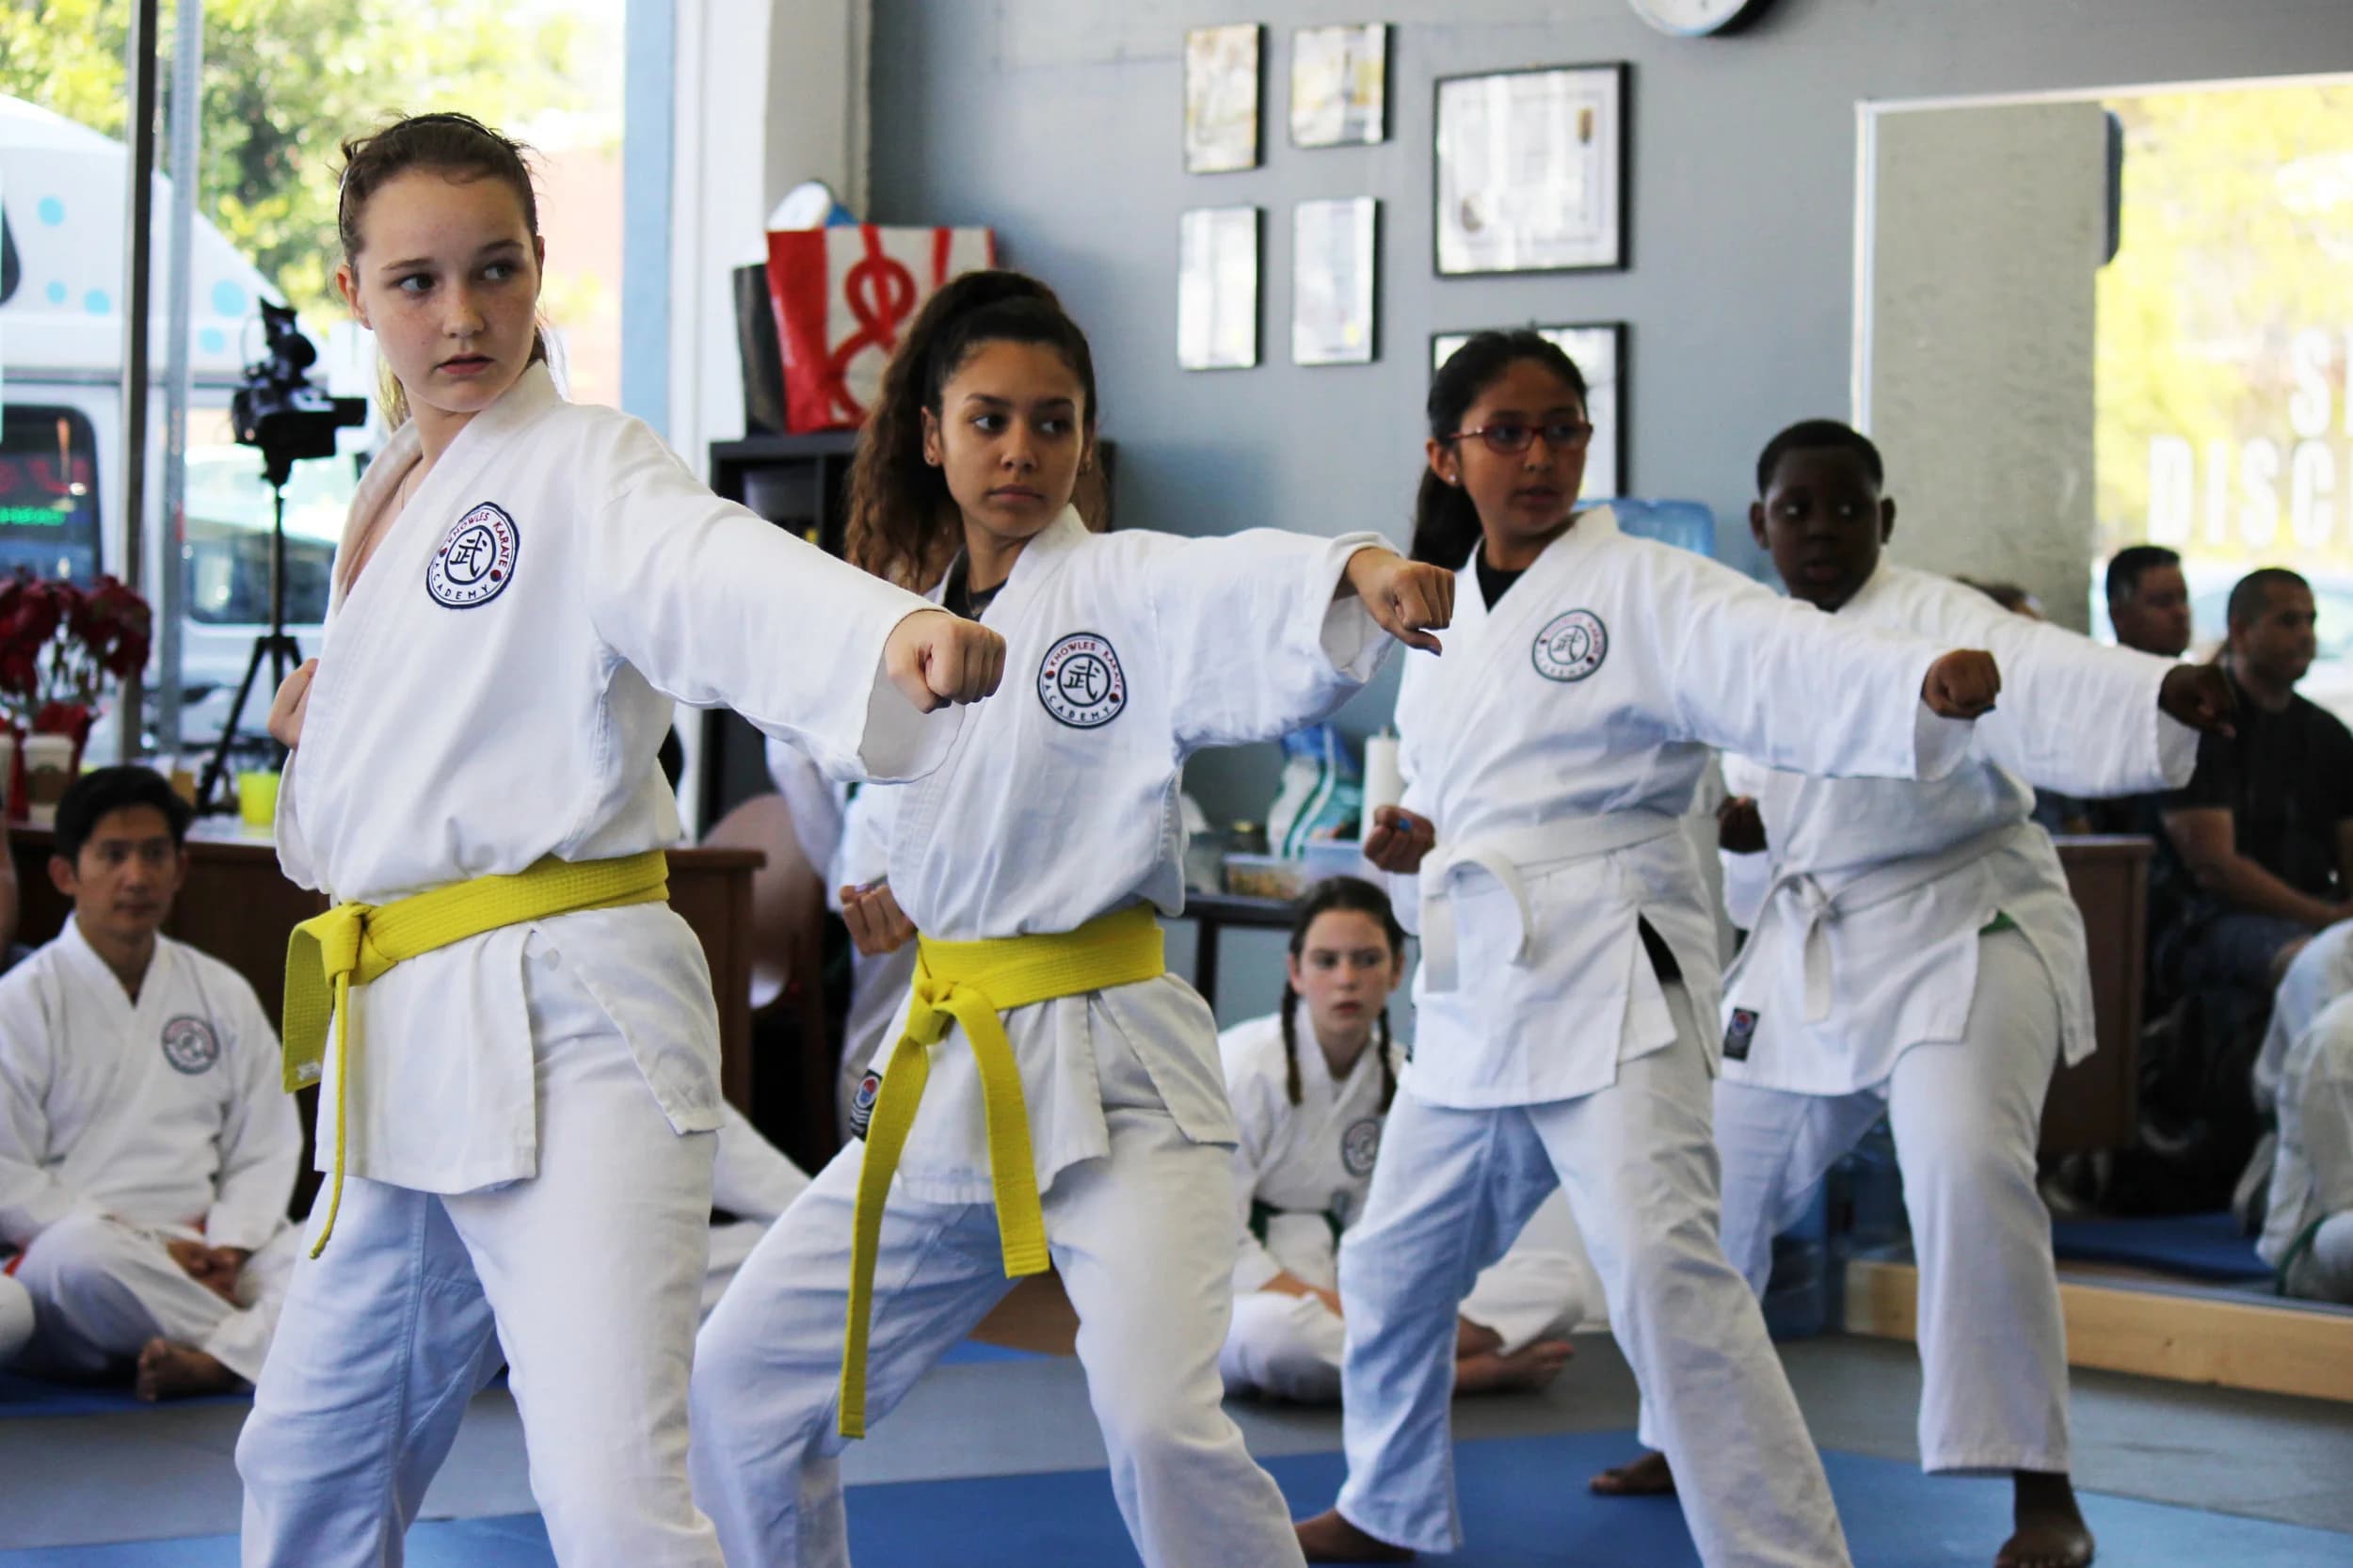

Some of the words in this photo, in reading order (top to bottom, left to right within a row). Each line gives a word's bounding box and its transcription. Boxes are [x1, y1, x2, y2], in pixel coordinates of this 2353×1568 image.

[2289, 328, 2353, 440] S
[2146, 436, 2353, 548] DISC
[493, 520, 509, 568] KARATE
[1050, 642, 1096, 666] KNOWLES
